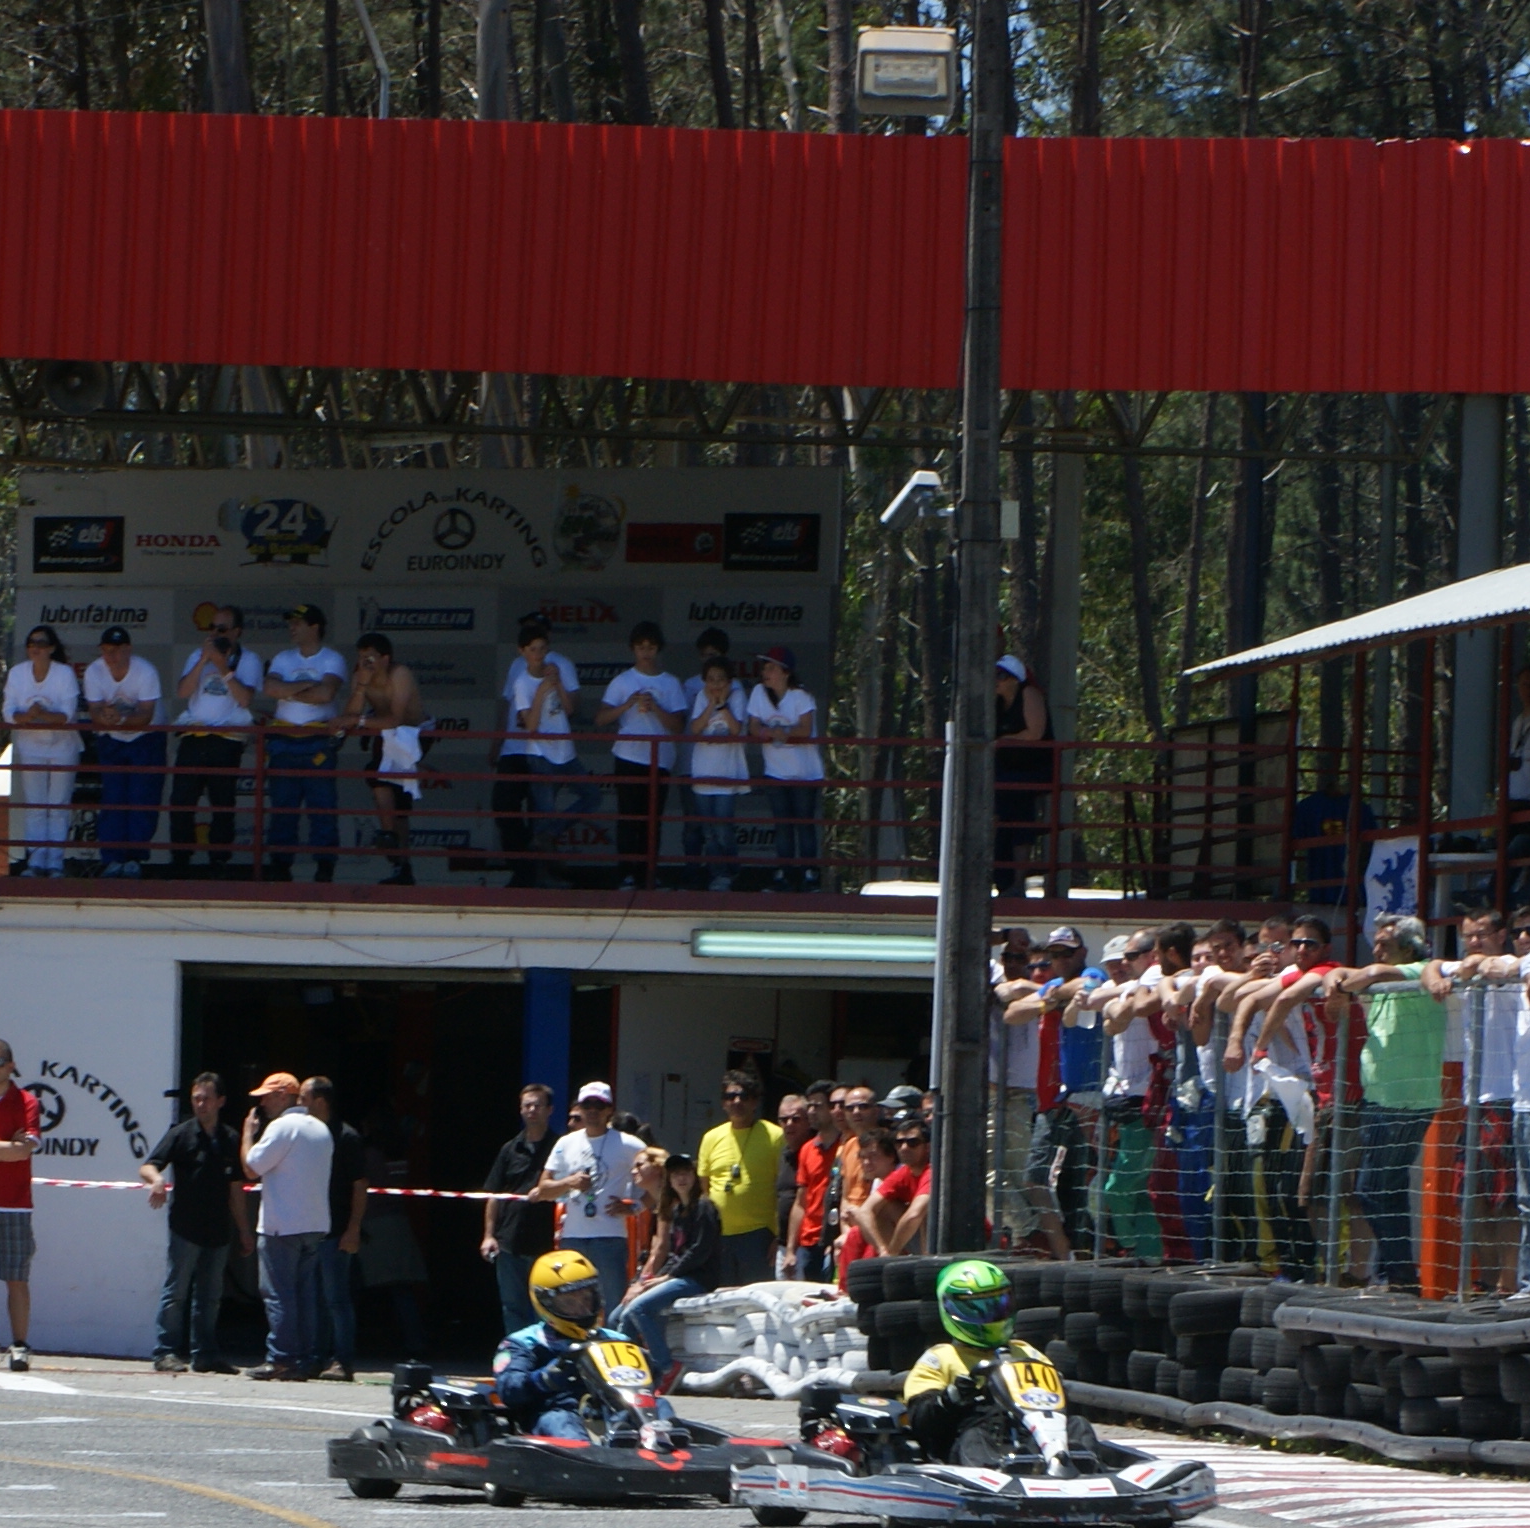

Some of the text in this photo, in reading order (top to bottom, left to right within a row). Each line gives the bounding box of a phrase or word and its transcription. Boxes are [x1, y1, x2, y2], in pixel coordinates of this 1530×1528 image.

[253, 502, 307, 537] 24
[360, 490, 439, 571] ESCOLA
[456, 487, 548, 568] KARTING
[135, 534, 221, 547] HONDA
[406, 553, 506, 572] EUROINDY
[381, 610, 471, 626] MICHELIN
[40, 1059, 149, 1159] KARTING
[600, 1343, 642, 1370] 115
[1012, 1363, 1058, 1393] 140
